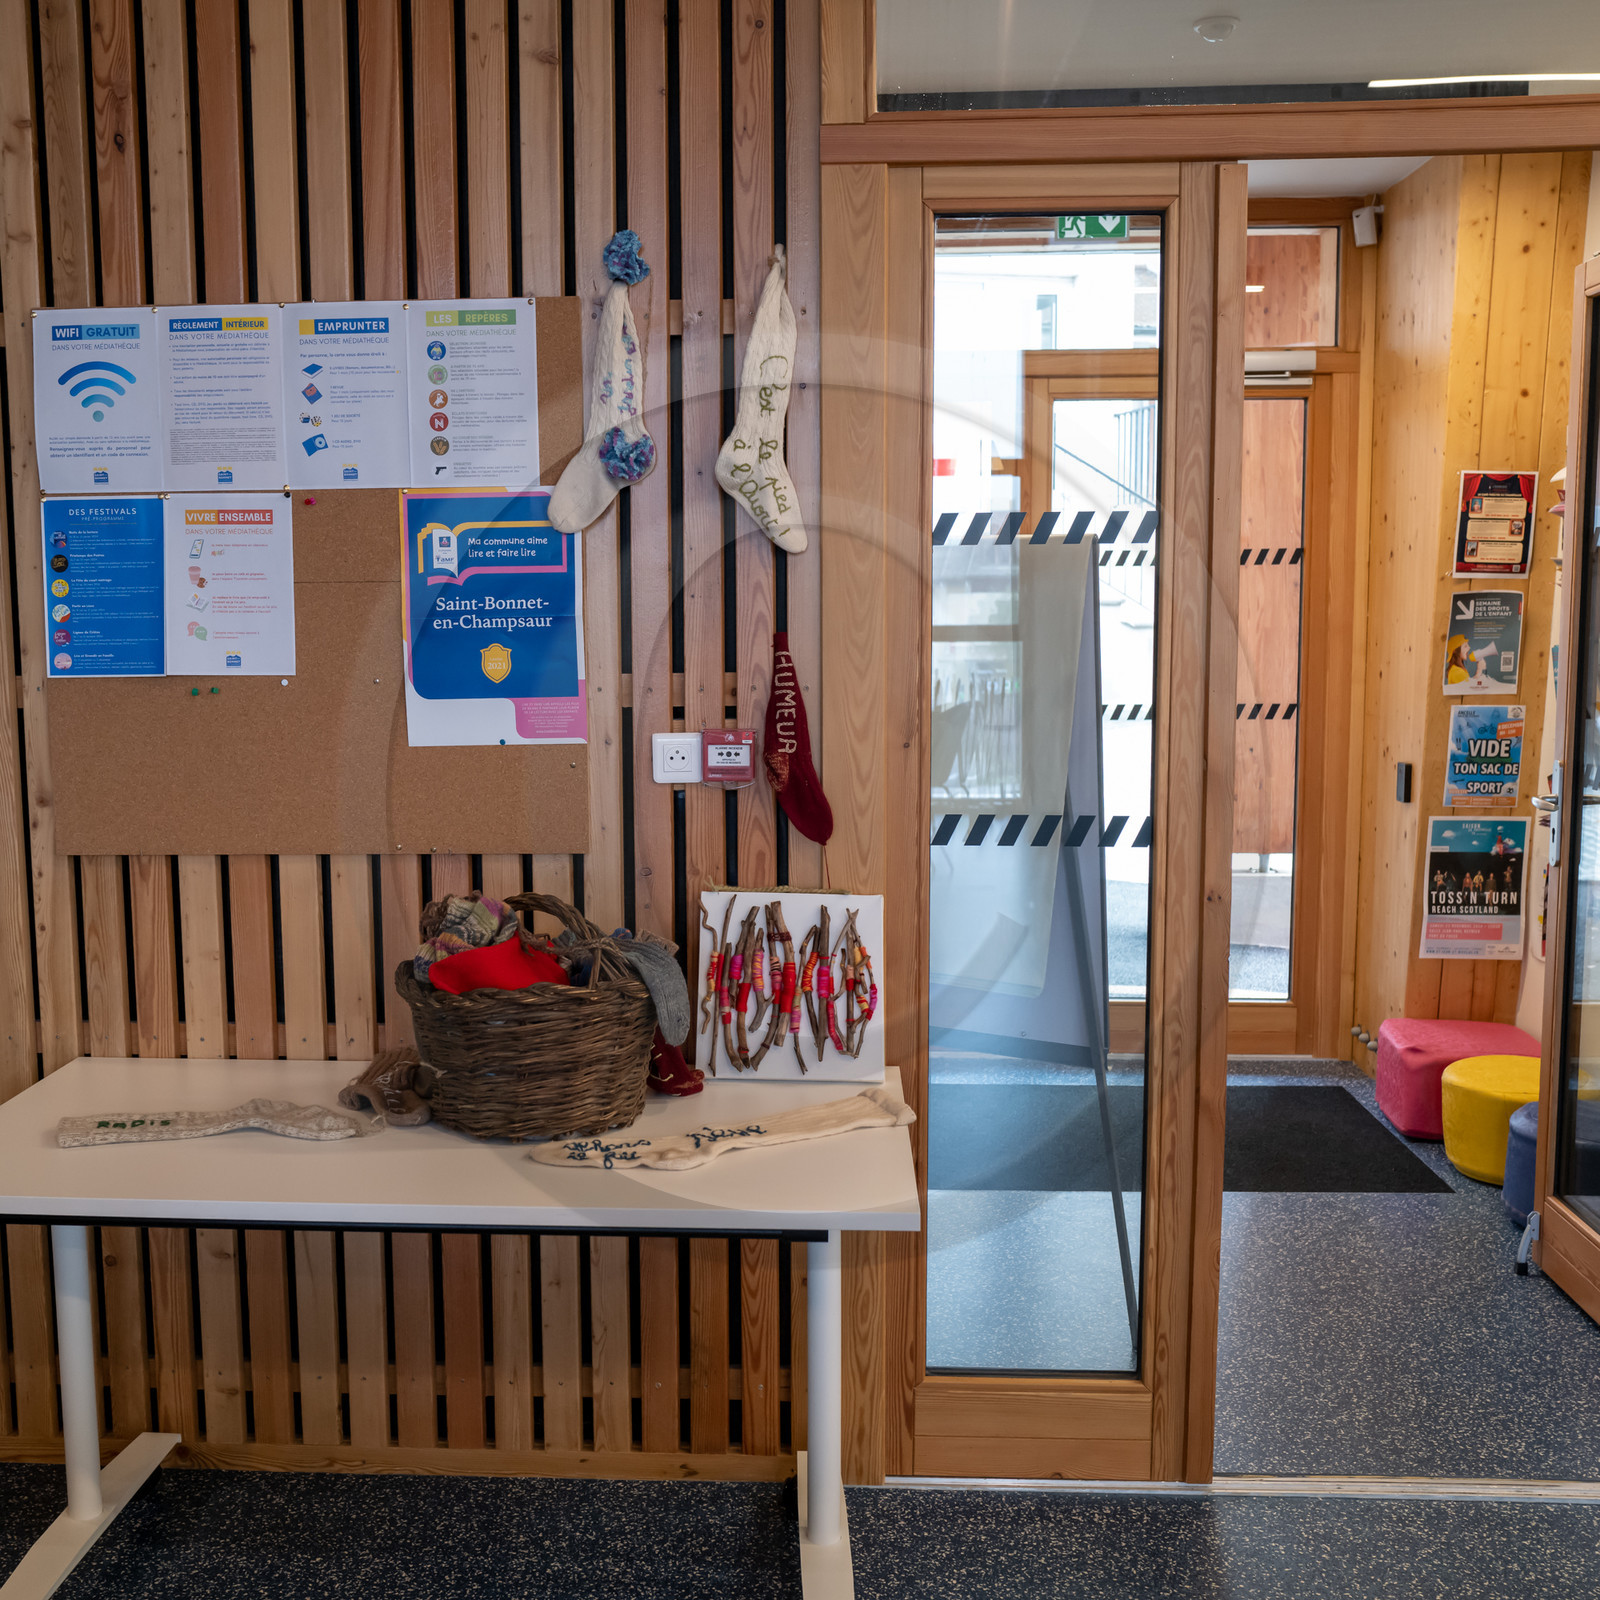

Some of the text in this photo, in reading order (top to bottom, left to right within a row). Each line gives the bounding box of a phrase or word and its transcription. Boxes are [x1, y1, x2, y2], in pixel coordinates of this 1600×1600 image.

[434, 312, 508, 324] LES REPÈRES
[173, 319, 264, 330] RÈGLEMENT INTÉRIEUR
[318, 321, 386, 331] EMPRUNTER
[55, 326, 136, 338] WIFI GRATUIT
[759, 355, 791, 515] C'est le pied
[186, 513, 271, 522] VIVRE ENSEMBLE
[468, 537, 481, 545] Ma
[527, 536, 548, 545] aime
[468, 549, 483, 558] lire
[497, 549, 519, 558] faire
[521, 549, 536, 557] lire
[436, 596, 550, 611] Saint-Bonnet-
[433, 614, 552, 632] en-Champsaur
[1469, 739, 1511, 757] VIDE
[1454, 763, 1519, 774] TON SAC DE
[1467, 782, 1502, 793] SPORT
[1431, 891, 1517, 904] TOSS'N TURN
[1432, 905, 1456, 913] REACH
